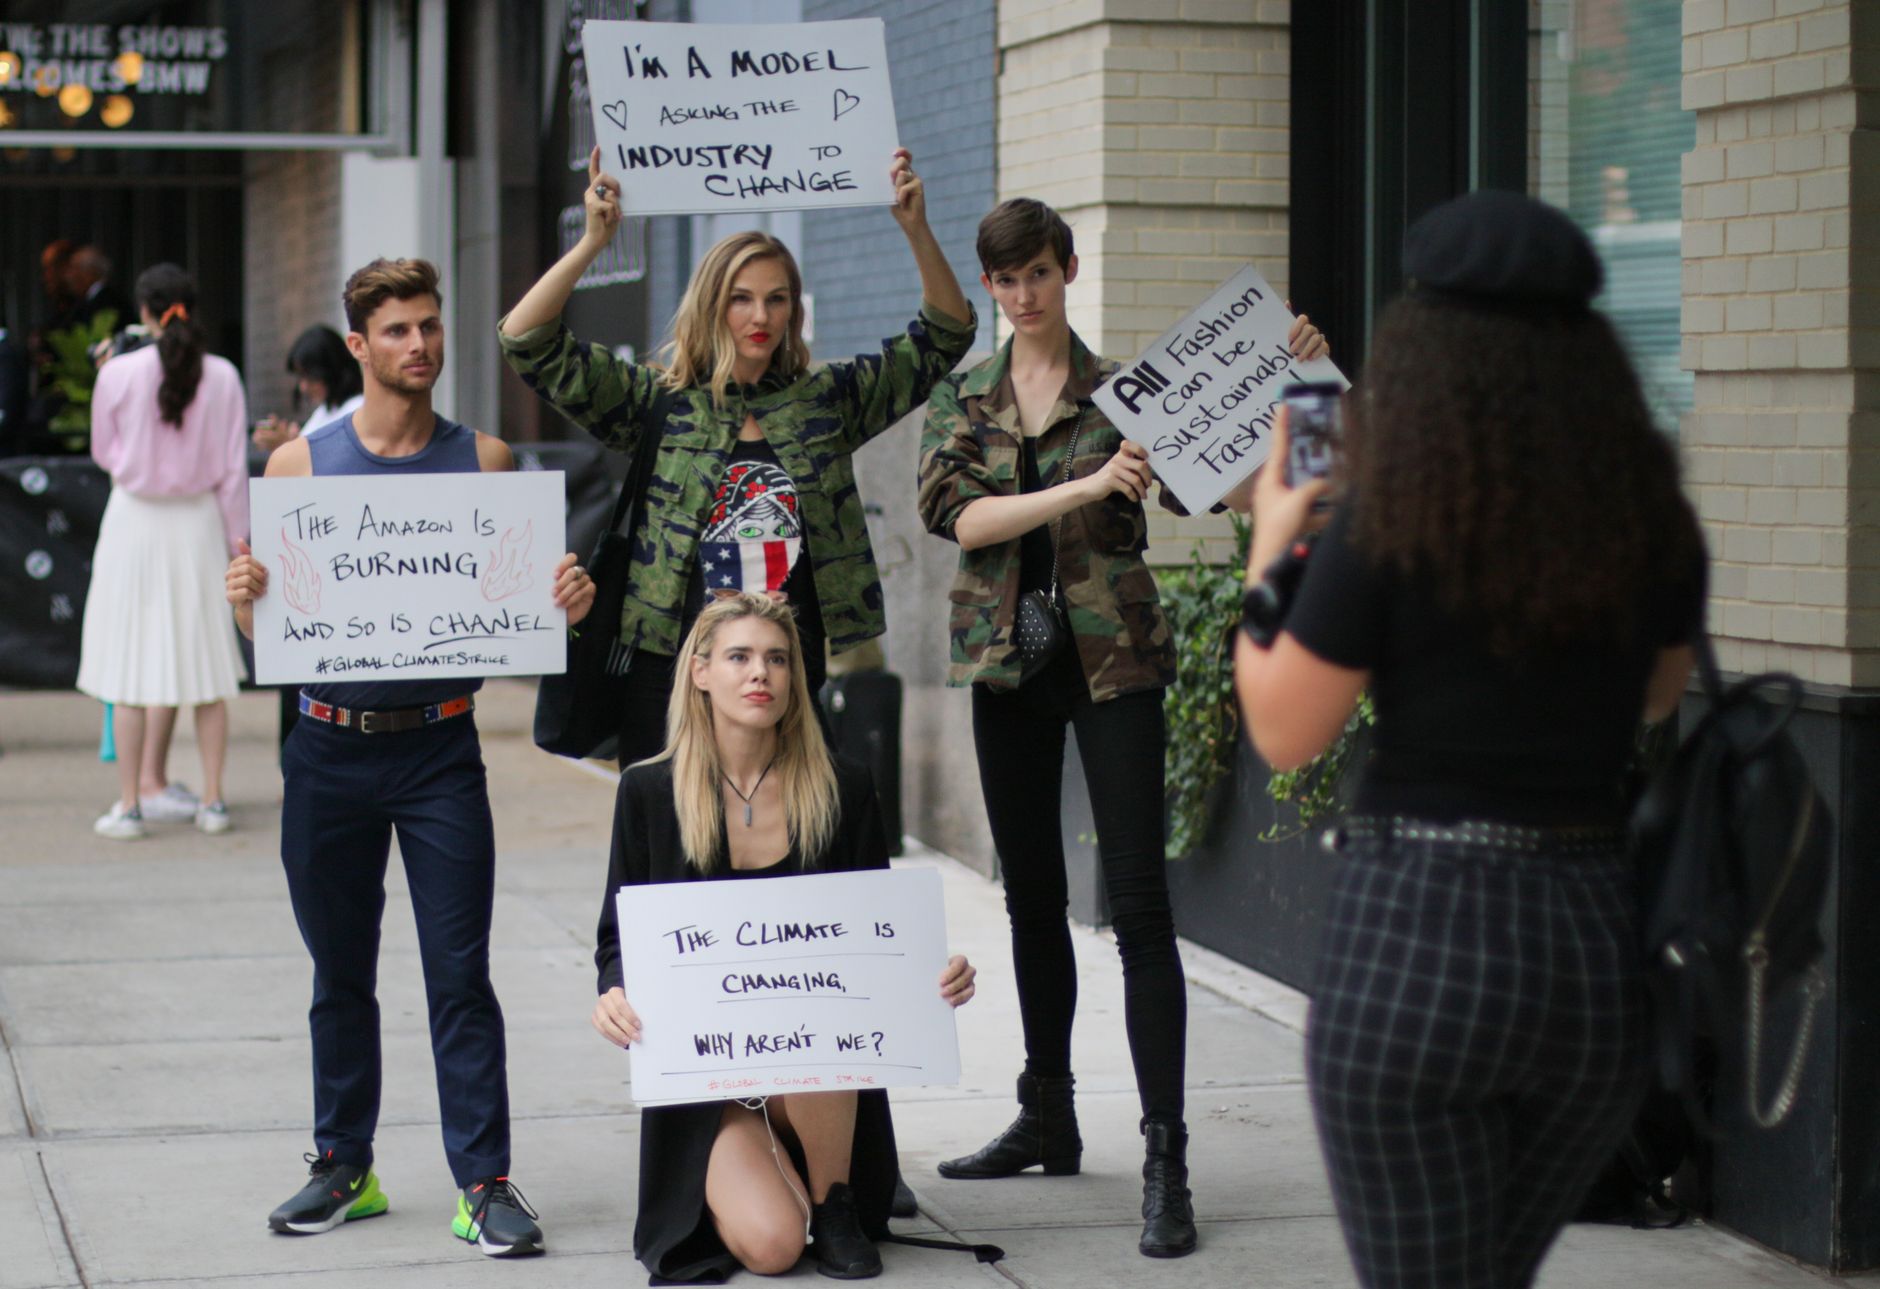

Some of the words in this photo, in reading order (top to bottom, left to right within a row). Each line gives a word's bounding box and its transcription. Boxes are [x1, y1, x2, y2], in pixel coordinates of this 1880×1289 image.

[50, 23, 110, 55] THE
[118, 25, 228, 60] SHOWS
[688, 46, 712, 79] A
[731, 49, 870, 78] MODEL
[660, 105, 739, 127] ASKING
[743, 99, 800, 117] THE
[618, 143, 773, 170] INDUSTRY
[809, 145, 842, 161] TO
[704, 169, 858, 199] CHANGE
[1112, 360, 1172, 415] All
[1165, 286, 1264, 367] Fashion
[1162, 371, 1213, 415] Can
[1212, 339, 1256, 367] be
[1152, 344, 1299, 461] Sustainabl
[282, 502, 339, 541] THE
[357, 504, 453, 541] AMAZON
[329, 552, 478, 581] BURNING
[283, 616, 334, 642] AND
[346, 615, 376, 640] SO
[391, 612, 412, 634] IS
[428, 608, 555, 637] CHANEL
[663, 924, 719, 955] THE
[736, 921, 849, 947] CLIMATE
[875, 922, 895, 939] IS
[722, 972, 847, 994] CHANGING,
[694, 1032, 734, 1060] WHY
[745, 1023, 817, 1057] AREN'T
[773, 1077, 821, 1086] CLIMATE
[835, 1074, 876, 1084] STRIKE
